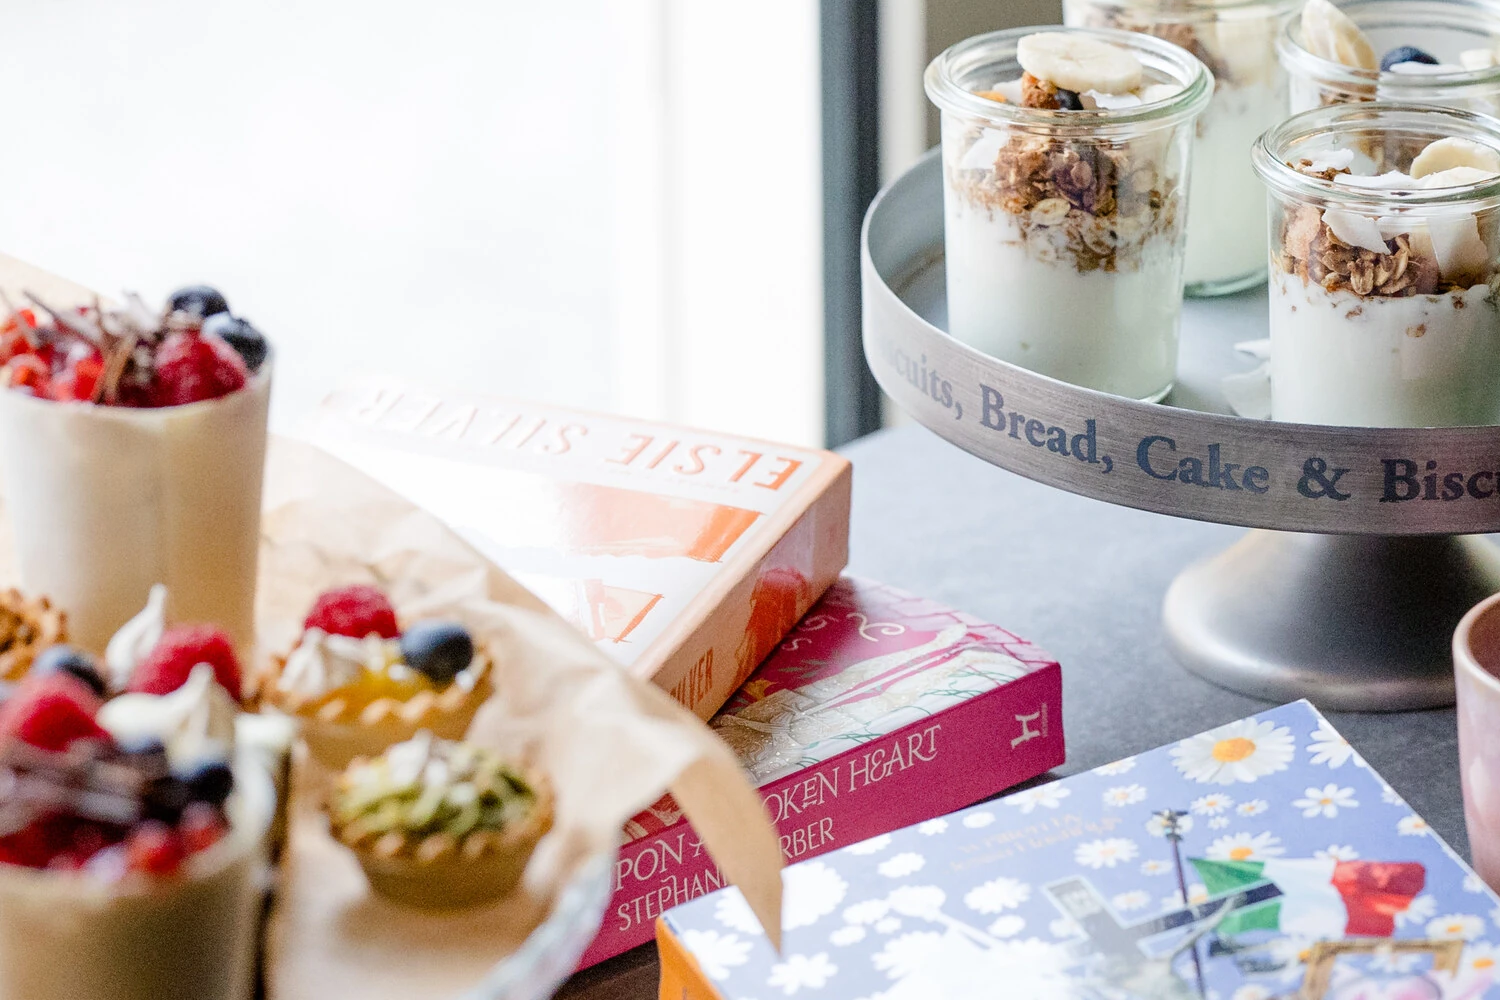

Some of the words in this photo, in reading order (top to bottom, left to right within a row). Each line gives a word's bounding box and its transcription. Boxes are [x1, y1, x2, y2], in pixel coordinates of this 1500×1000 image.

[604, 433, 804, 491] ELSIE
[887, 345, 964, 420] cuits,
[979, 382, 1114, 474] Bread,
[1136, 434, 1271, 495] Cake
[1297, 456, 1351, 501] &
[615, 832, 686, 892] PON
[761, 766, 840, 826] OKEN
[848, 724, 942, 793] HEART
[777, 816, 835, 859] RBER
